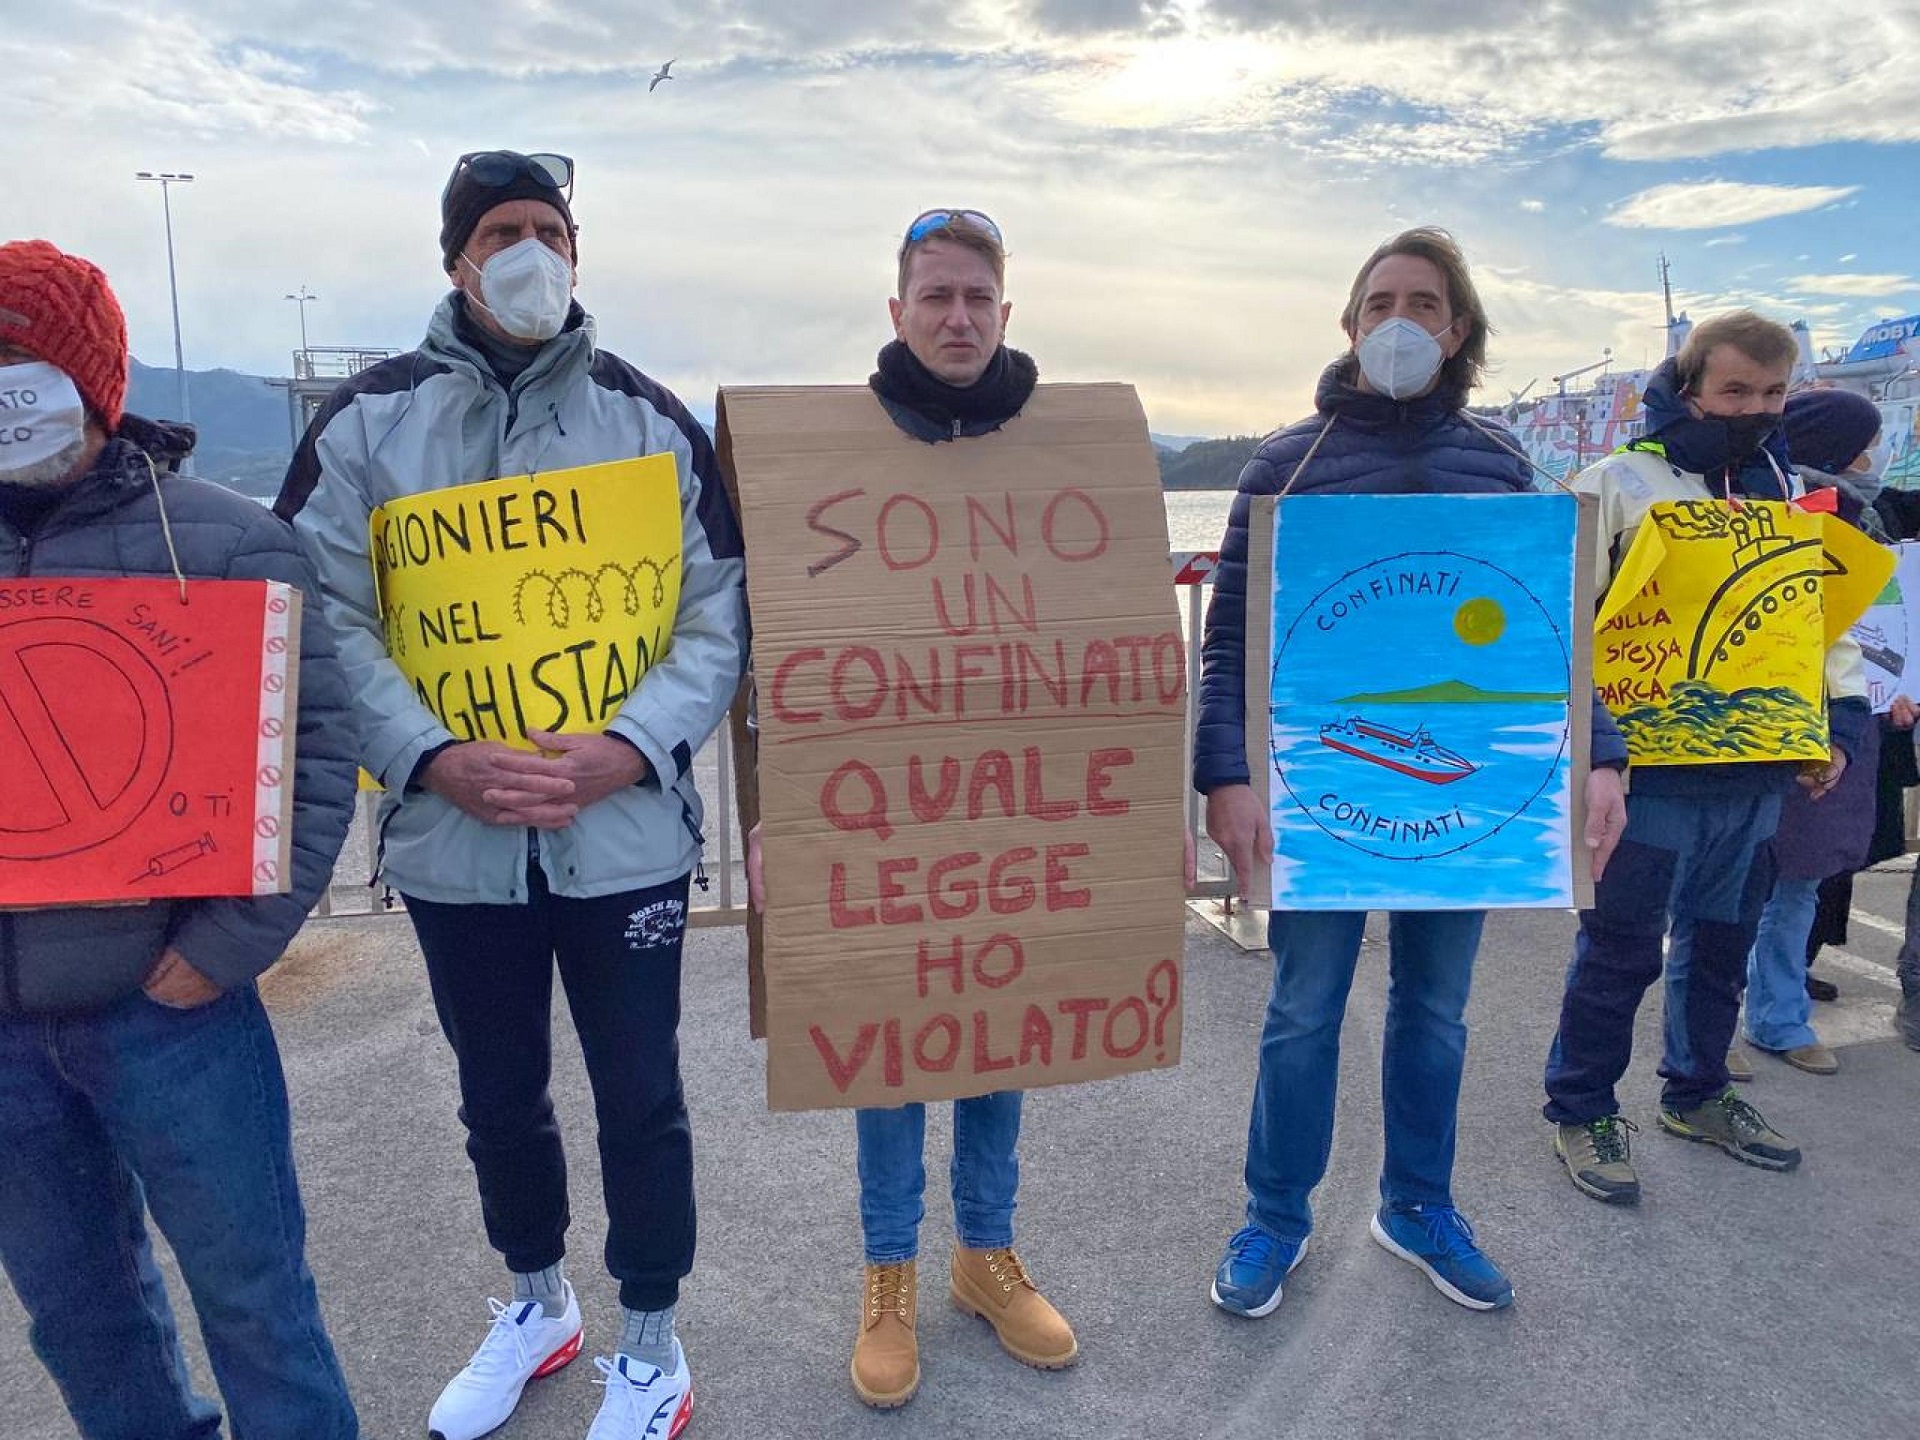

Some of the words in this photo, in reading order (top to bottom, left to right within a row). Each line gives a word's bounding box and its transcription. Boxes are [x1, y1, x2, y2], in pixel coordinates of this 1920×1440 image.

[1861, 321, 1919, 346] MOBY
[805, 487, 1109, 578] SONO
[418, 600, 502, 648] NEL
[932, 572, 1039, 637] UN
[772, 632, 1186, 725] CONFINATO
[820, 746, 1135, 841] QUALE
[828, 842, 1092, 929] LEGGE
[917, 932, 1025, 998] HO
[809, 959, 1179, 1094] VIOLATO?
